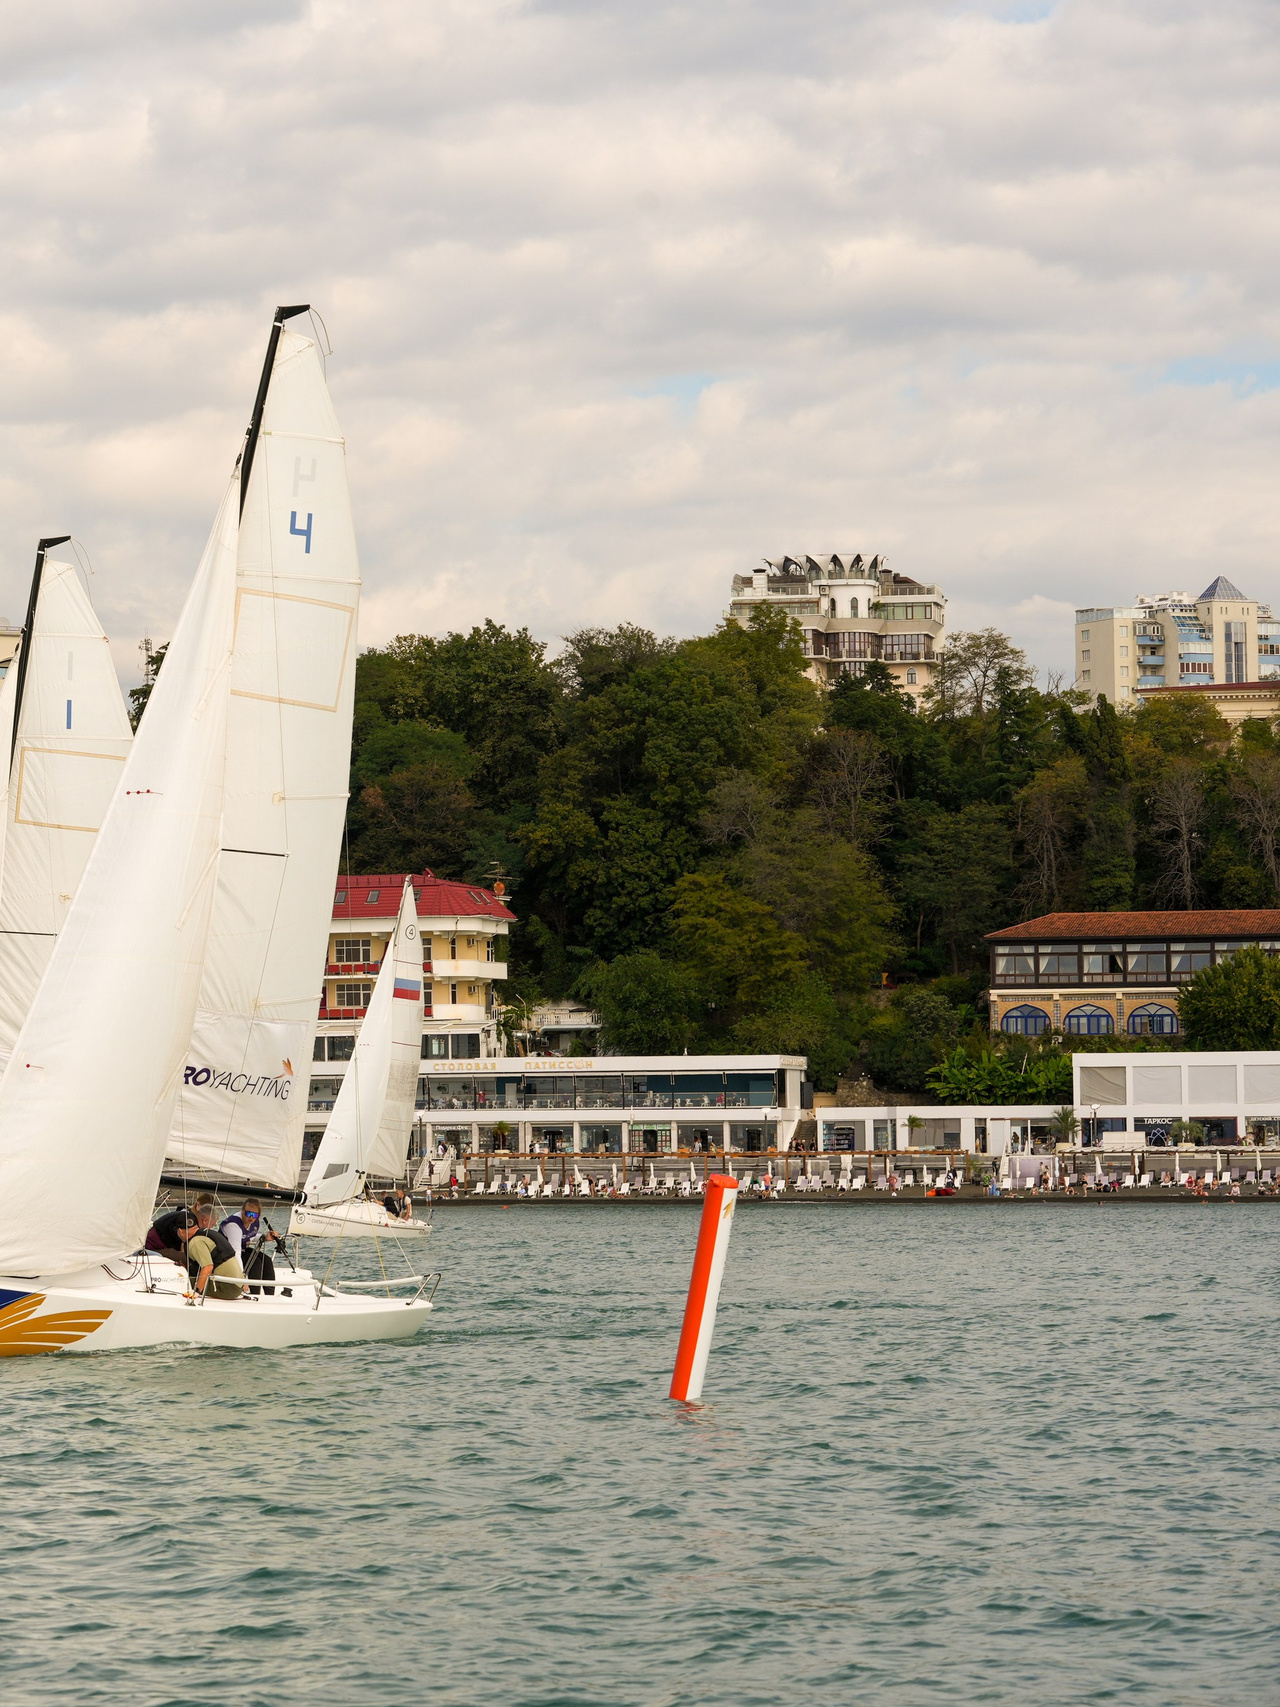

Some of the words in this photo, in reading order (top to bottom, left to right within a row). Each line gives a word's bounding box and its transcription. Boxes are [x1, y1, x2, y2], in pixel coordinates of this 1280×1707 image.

[289, 510, 313, 554] 4
[433, 1062, 497, 1071] СТОЛОВАЯ
[183, 1065, 291, 1100] ROYACHTING
[1143, 1117, 1173, 1125] ТАРКОС
